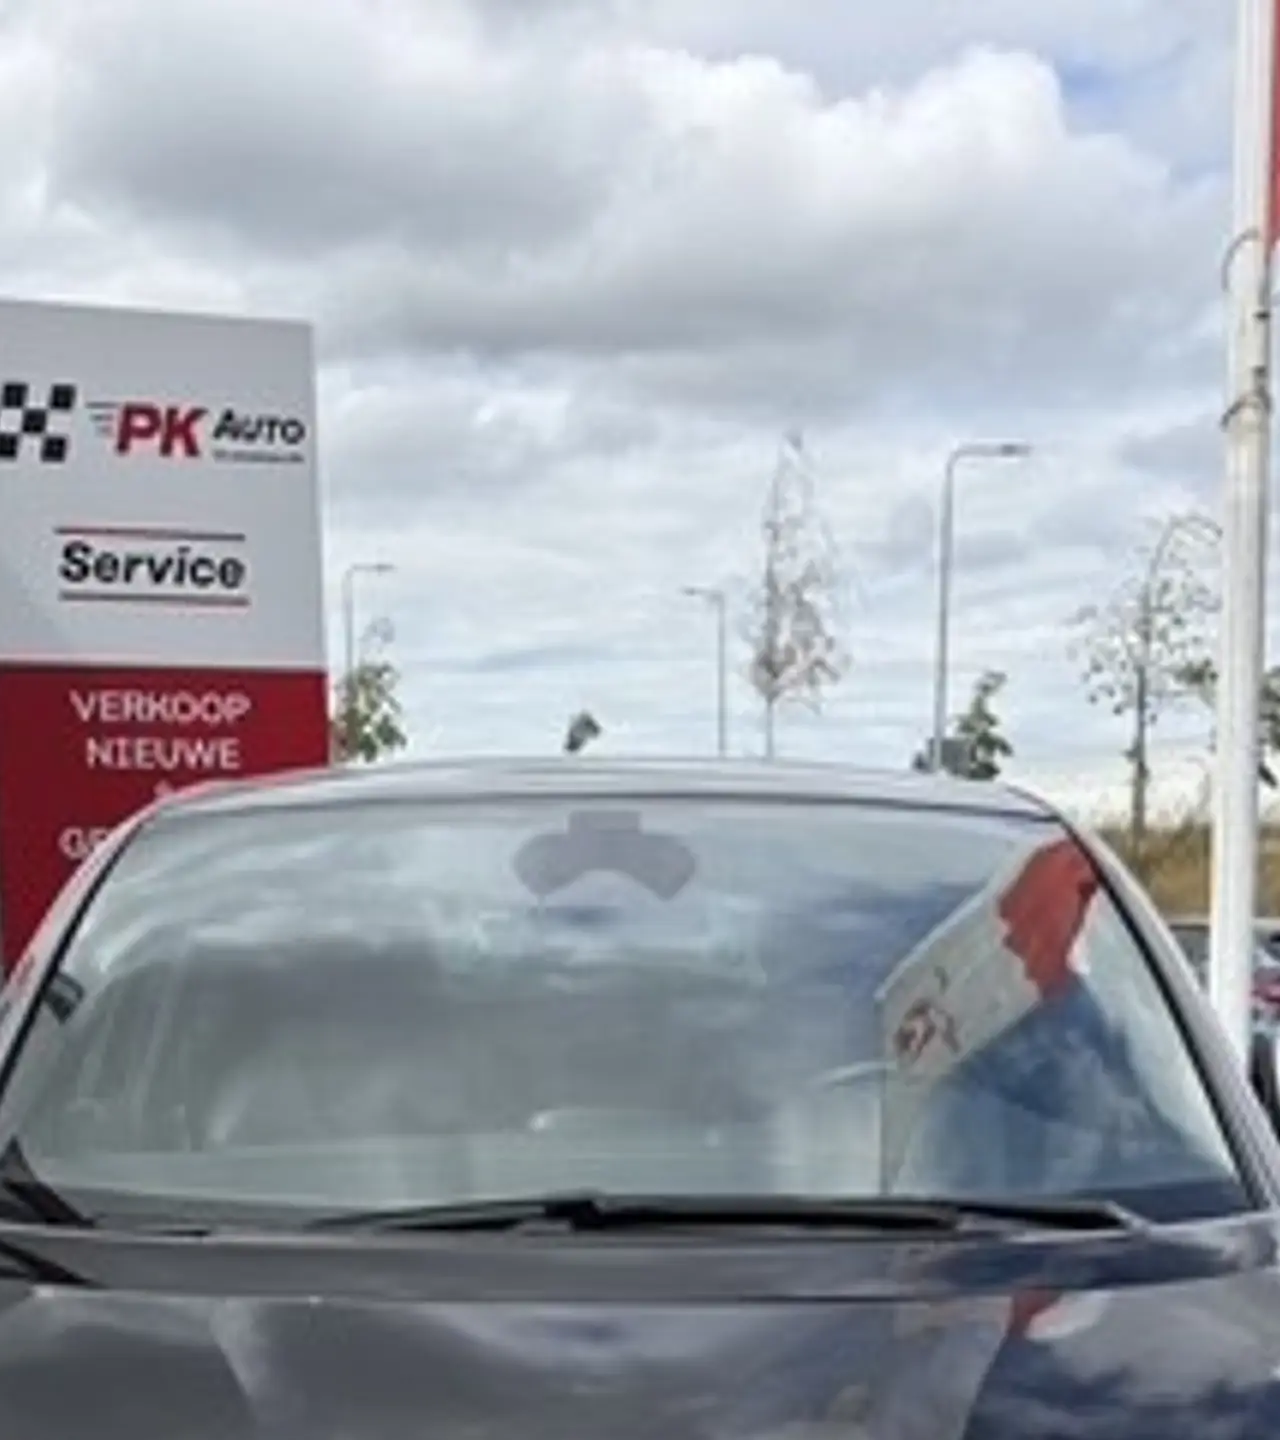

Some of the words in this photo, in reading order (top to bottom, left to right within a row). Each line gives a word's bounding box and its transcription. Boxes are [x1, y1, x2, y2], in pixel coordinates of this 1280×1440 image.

[117, 403, 208, 457] PK
[59, 541, 245, 590] Service
[69, 690, 252, 725] VERKOOP
[86, 737, 240, 770] NIEUWE
